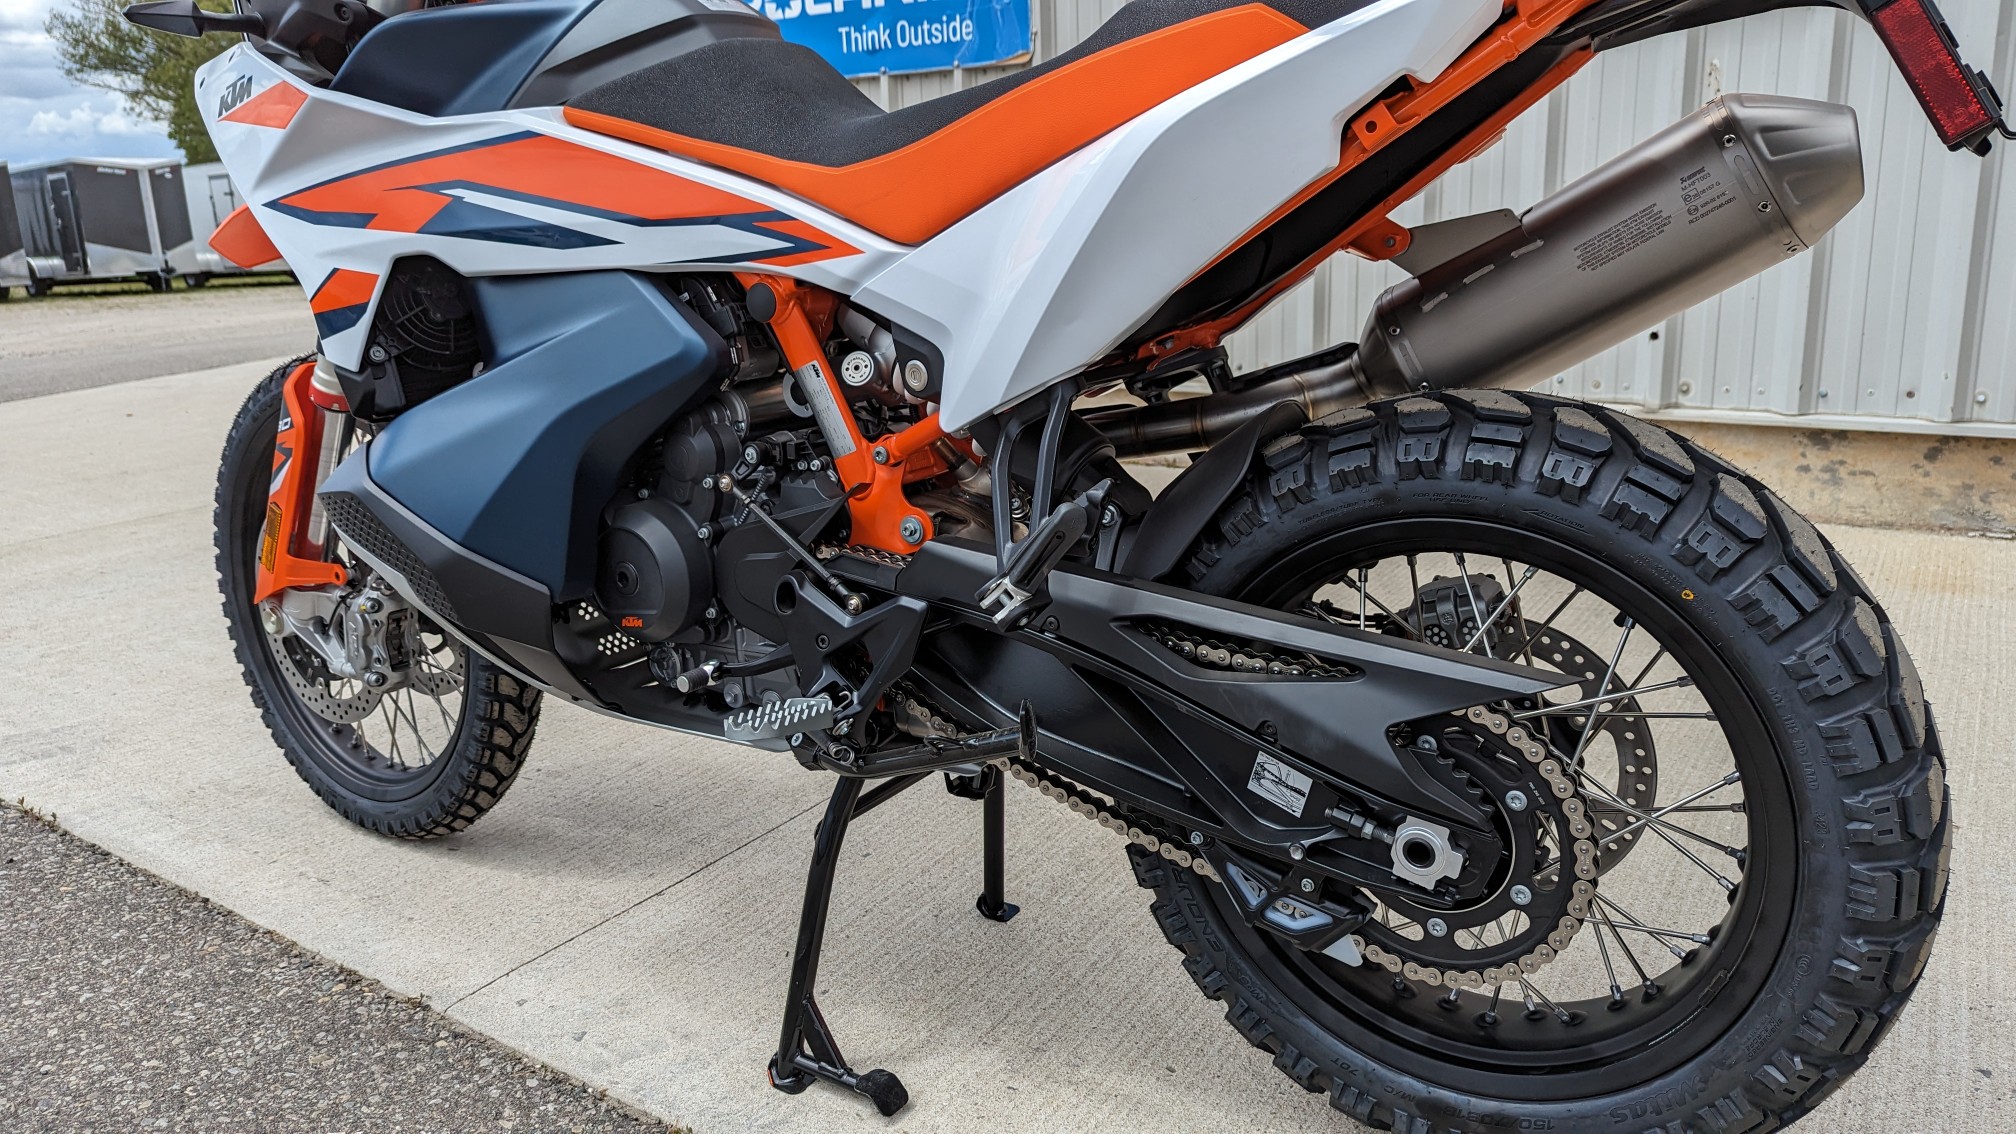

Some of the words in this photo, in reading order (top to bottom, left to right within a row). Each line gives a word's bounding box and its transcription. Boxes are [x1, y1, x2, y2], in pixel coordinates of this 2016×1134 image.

[838, 22, 892, 54] Think
[897, 15, 974, 47] Outside
[218, 74, 253, 118] KTM
[811, 364, 821, 379] KTM
[1540, 510, 1585, 529] ROTATION
[622, 616, 643, 627] KTM
[1330, 1057, 1360, 1076] 70T
